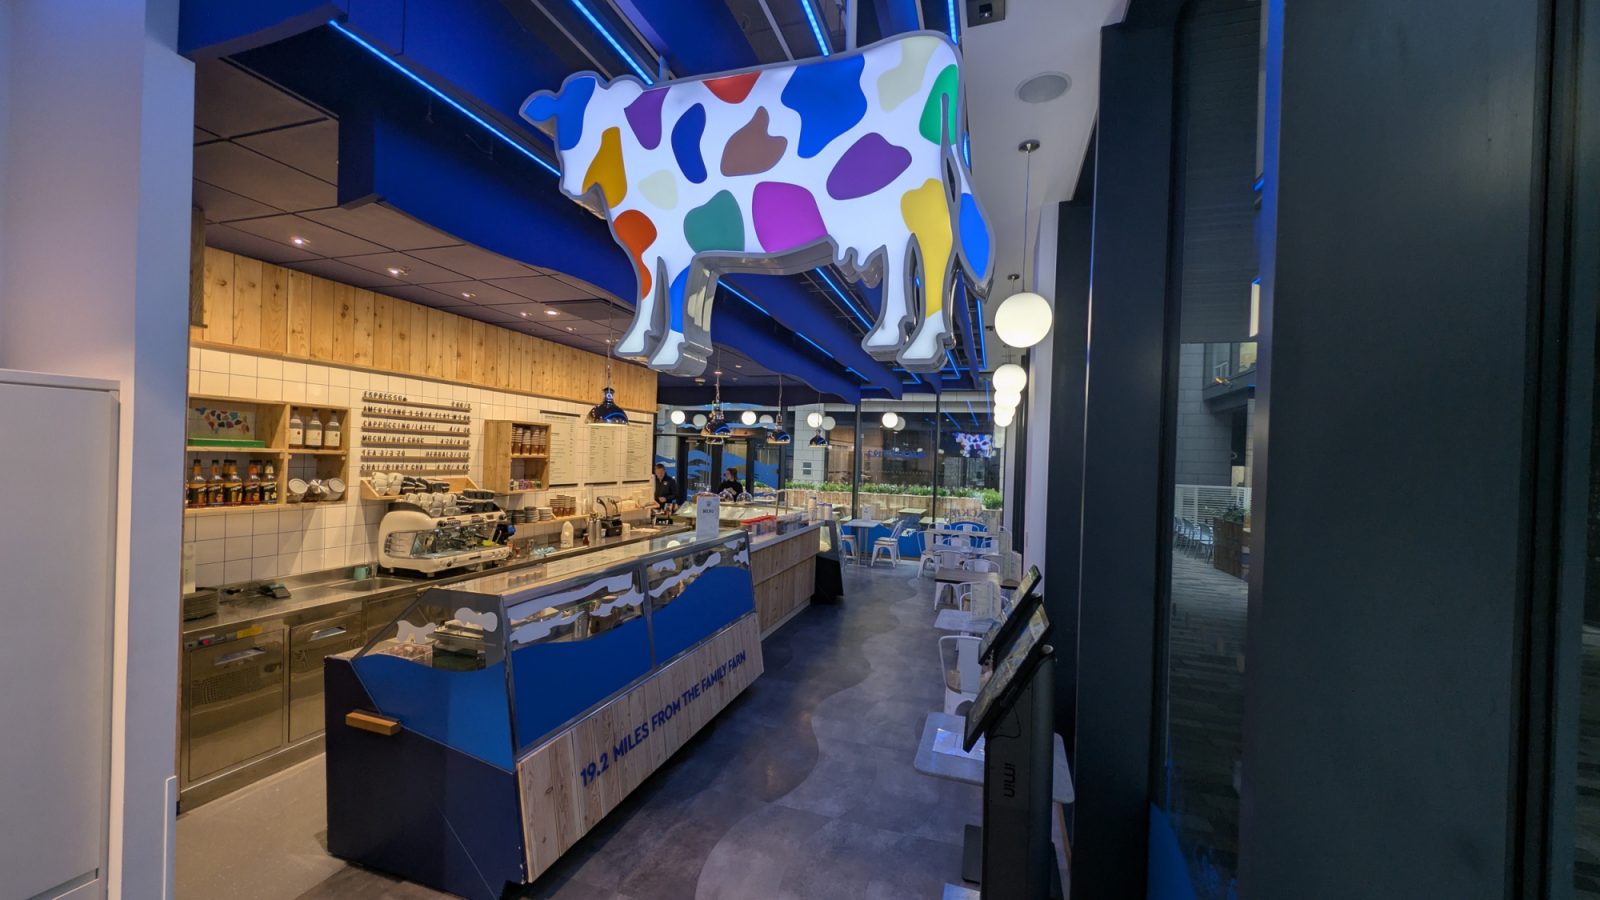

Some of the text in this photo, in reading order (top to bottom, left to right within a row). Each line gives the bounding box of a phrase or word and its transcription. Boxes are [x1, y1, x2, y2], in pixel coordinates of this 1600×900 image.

[580, 649, 747, 787] 19.2 MILES FROM THE FAMILY FARM
